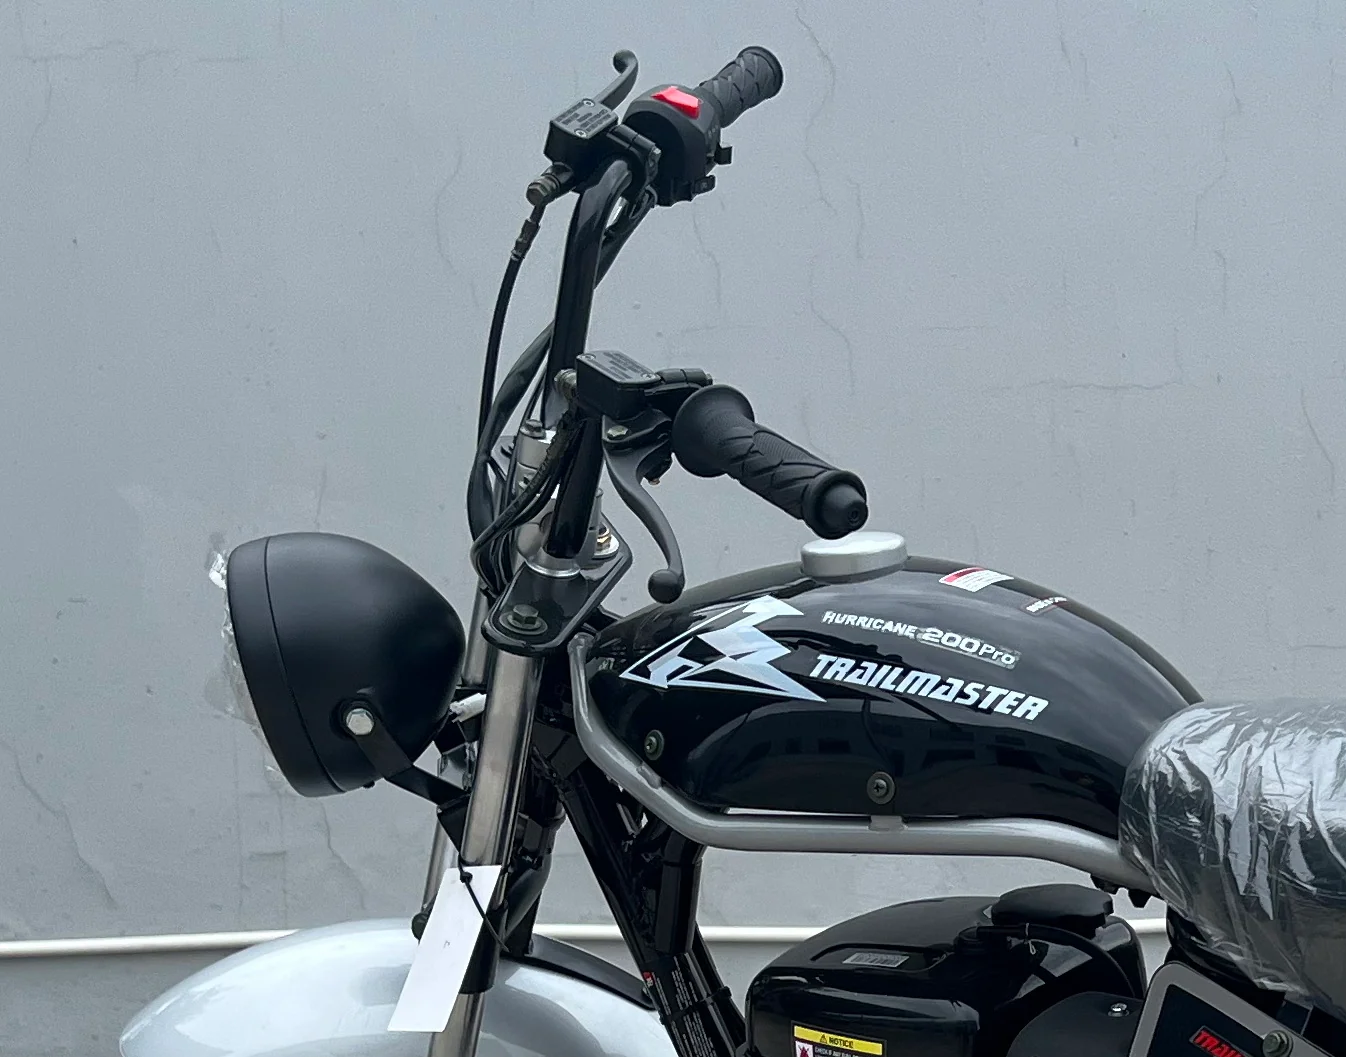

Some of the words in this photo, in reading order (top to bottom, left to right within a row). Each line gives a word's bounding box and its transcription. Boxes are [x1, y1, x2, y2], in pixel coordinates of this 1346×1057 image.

[821, 610, 918, 640] HURRICANE
[808, 653, 1050, 722] TRAILMASTER
[829, 1036, 853, 1048] NOTICE
